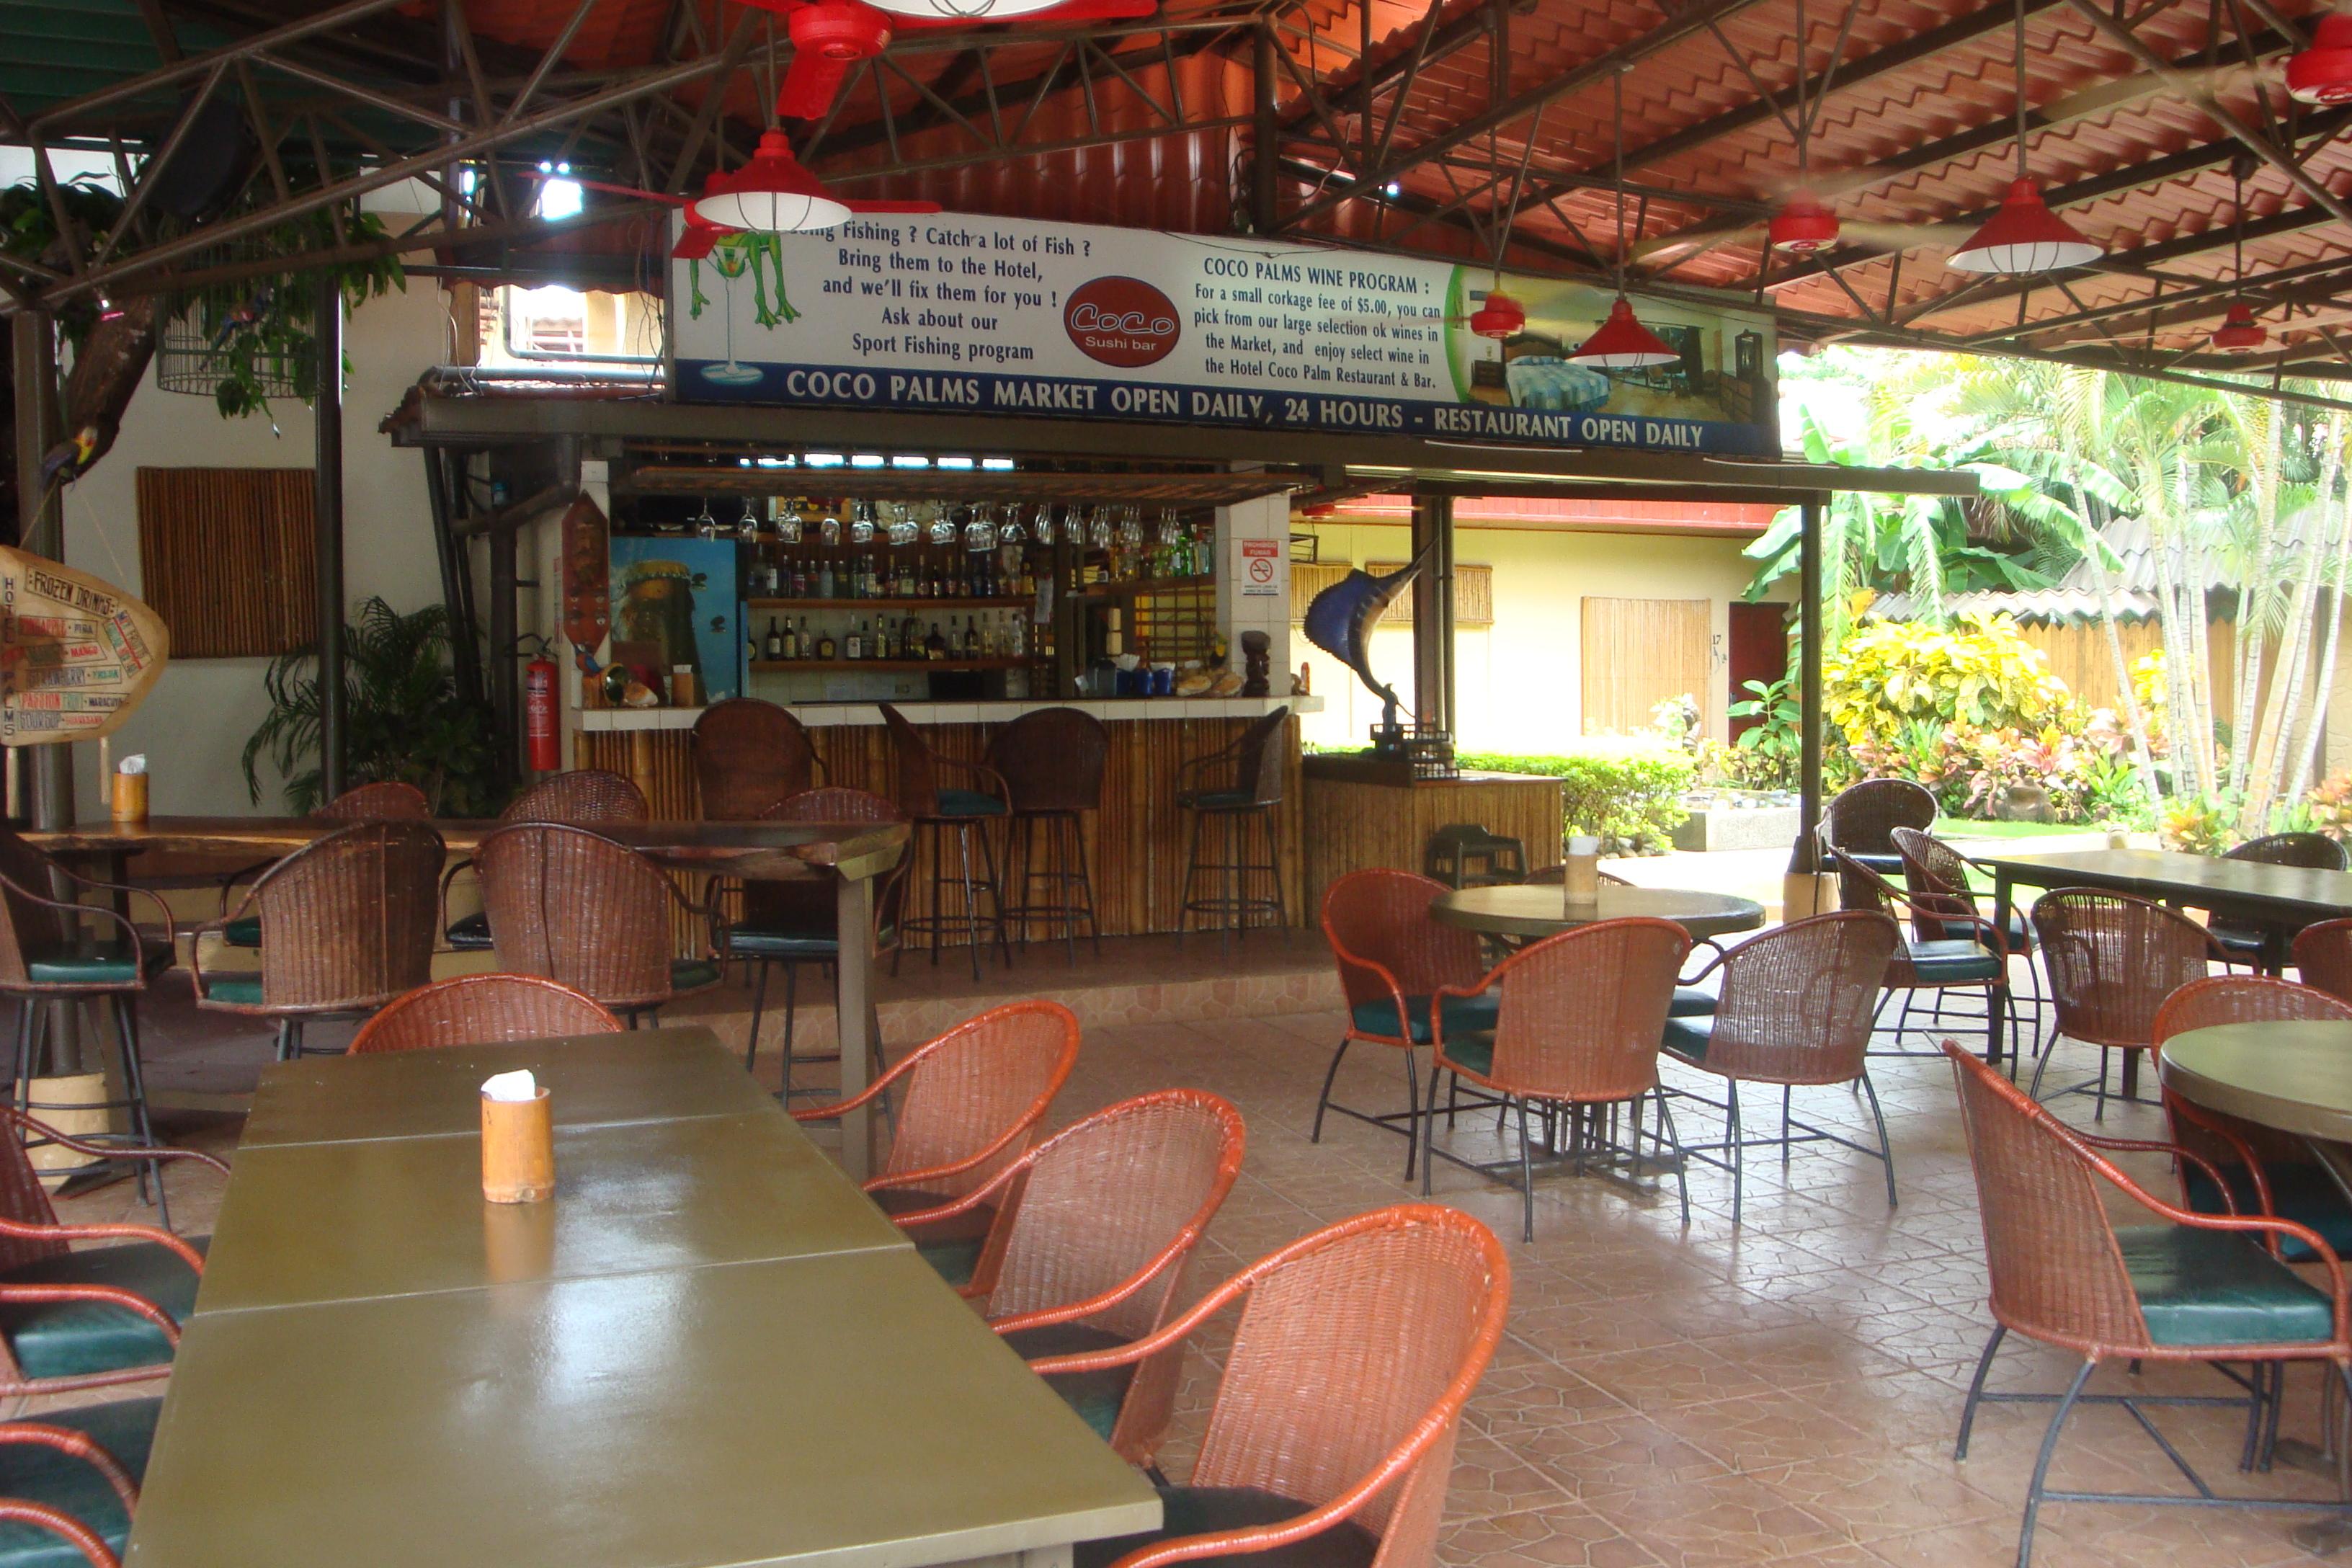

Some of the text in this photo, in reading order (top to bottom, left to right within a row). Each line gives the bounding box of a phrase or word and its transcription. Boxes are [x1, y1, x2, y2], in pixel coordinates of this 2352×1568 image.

[843, 220, 900, 247] Fishing
[909, 226, 917, 243] ?
[926, 227, 971, 247] Catch
[979, 236, 986, 249] a
[994, 231, 1015, 251] lot
[1022, 235, 1038, 252] of
[1046, 236, 1074, 255] Fish
[1083, 240, 1090, 257] ?
[839, 248, 1043, 283] Bring them to the Hotel,
[1204, 257, 1429, 295] COCO PALMS WINE PROGRAM :
[823, 275, 1056, 311] and we'll fix them for you !
[1195, 282, 1441, 321] For a small corkage fee of $5.00, you can
[881, 306, 998, 331] Ask about our
[1194, 307, 1438, 342] pick from our large selection ok wines in
[852, 333, 1033, 364] Sport Fishing program
[1085, 336, 1157, 351] Sushi bar
[1206, 332, 1430, 365] the Market, and enjoy select wine in
[1206, 357, 1436, 389] the Hotel Coco Palm Restaurant & Bar.
[786, 370, 876, 400] COCO
[890, 375, 980, 404] PALMS
[994, 380, 1098, 410] MARKET
[1110, 386, 1180, 414] OPEN
[1192, 391, 1273, 424] DAILY,
[1285, 398, 1309, 422] 24
[1319, 400, 1403, 427] HOURS
[1434, 408, 1572, 439] RESTAURANT
[1581, 417, 1636, 443] OPEN
[1646, 422, 1703, 447] DAILY
[35, 571, 112, 615] FROZEN DRINKS
[1712, 633, 1721, 645] 17
